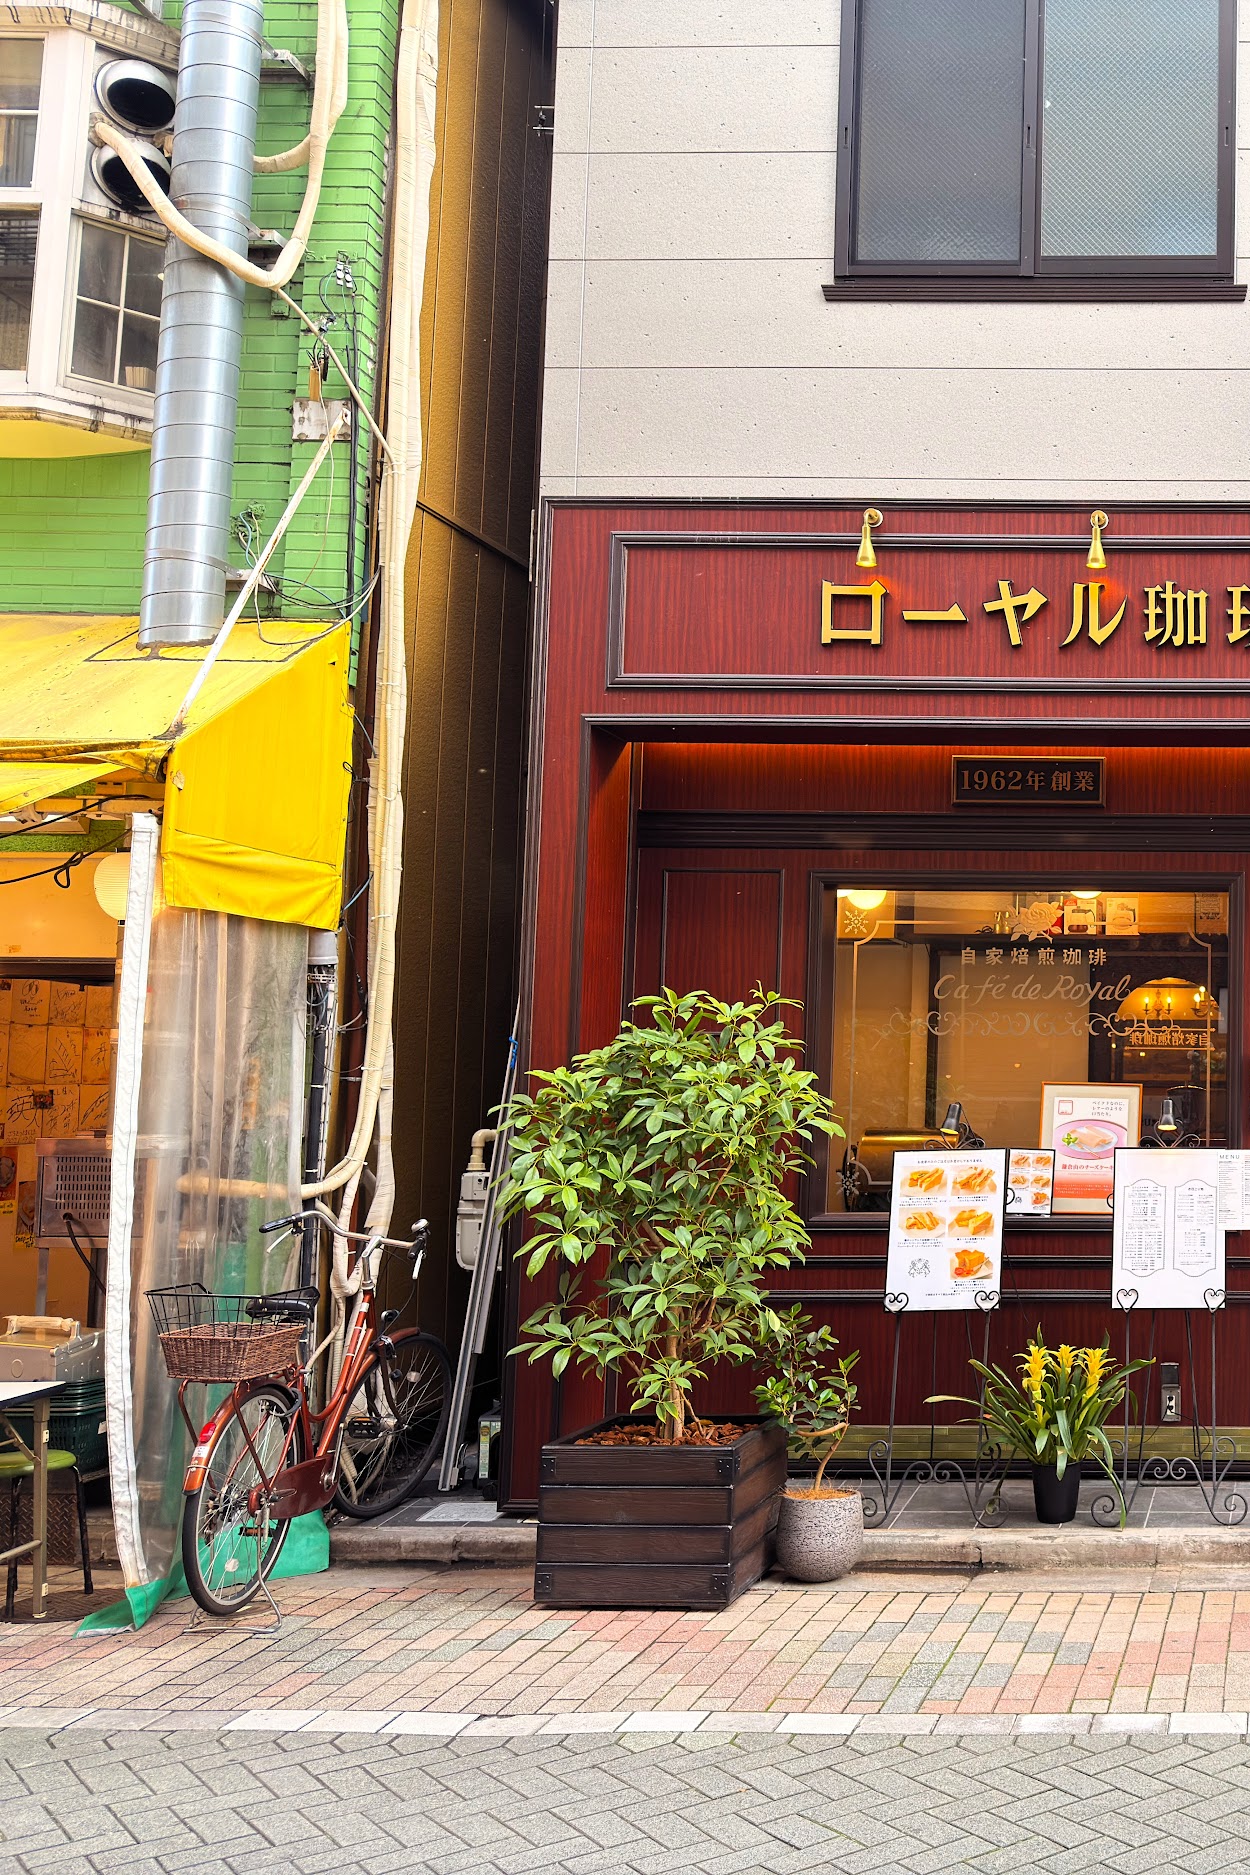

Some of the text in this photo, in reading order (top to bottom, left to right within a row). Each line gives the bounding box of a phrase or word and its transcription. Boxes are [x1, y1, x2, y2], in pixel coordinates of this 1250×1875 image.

[960, 769, 1096, 793] 1962年創業
[960, 946, 1107, 967] 自家焙煎珈琲
[1012, 974, 1041, 1000] de
[1043, 974, 1132, 1007] Royal
